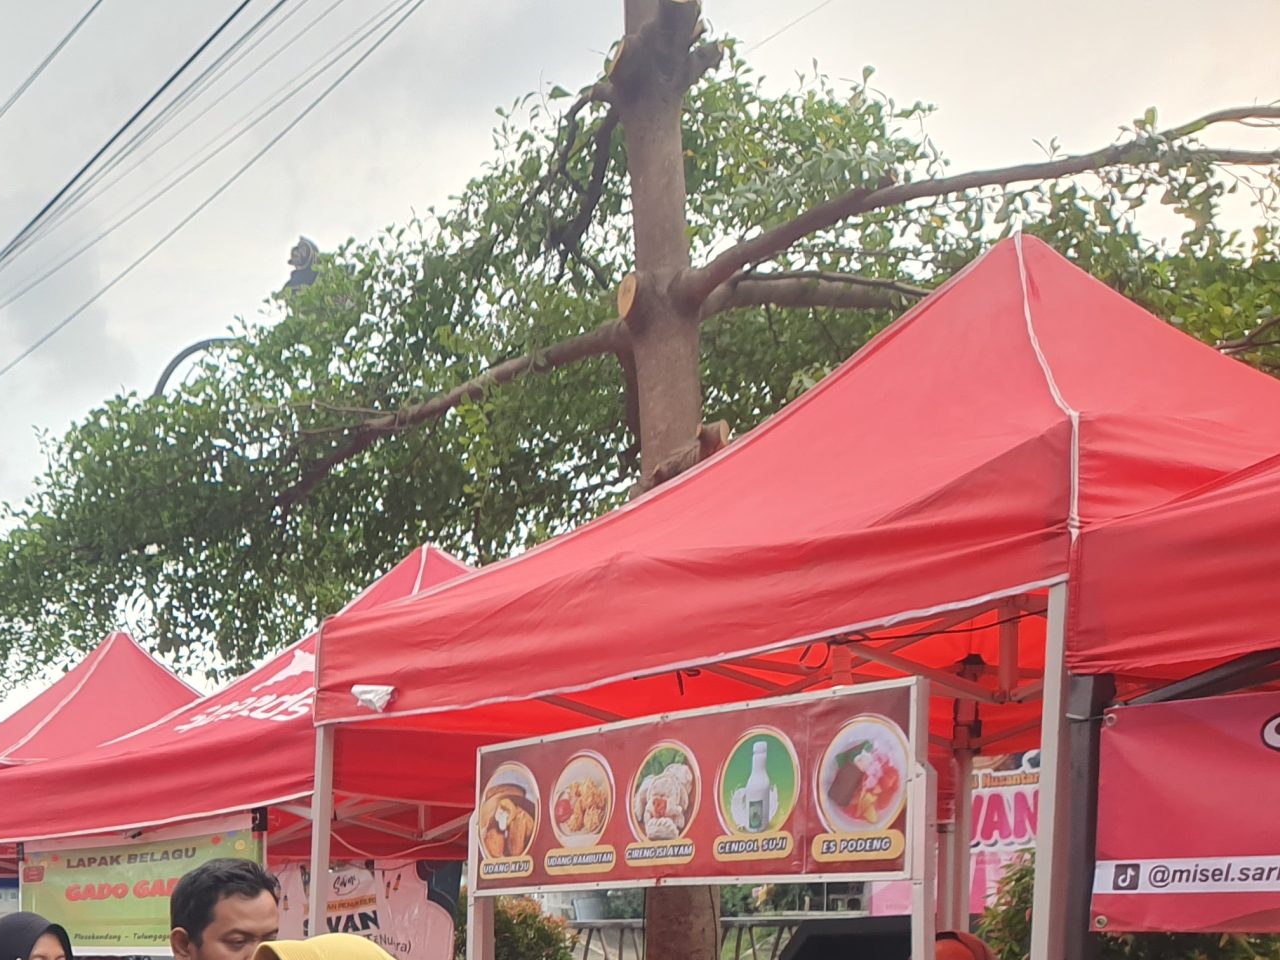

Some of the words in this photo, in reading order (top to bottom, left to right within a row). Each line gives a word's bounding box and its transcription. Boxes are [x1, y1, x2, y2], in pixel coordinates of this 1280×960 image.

[625, 849, 654, 860] CIRENG
[668, 845, 693, 857] AYAM
[717, 841, 759, 854] CENDOL
[761, 837, 787, 851] SUJI
[821, 840, 835, 853] ES
[839, 837, 891, 852] PODENG
[66, 854, 121, 869] LAPAK
[126, 847, 197, 864] BELAGU
[547, 856, 572, 866] UDANG
[573, 852, 613, 865] RAMBUTAN
[482, 863, 509, 874] UDANG
[65, 882, 129, 901] GADO
[133, 877, 181, 899] GAD
